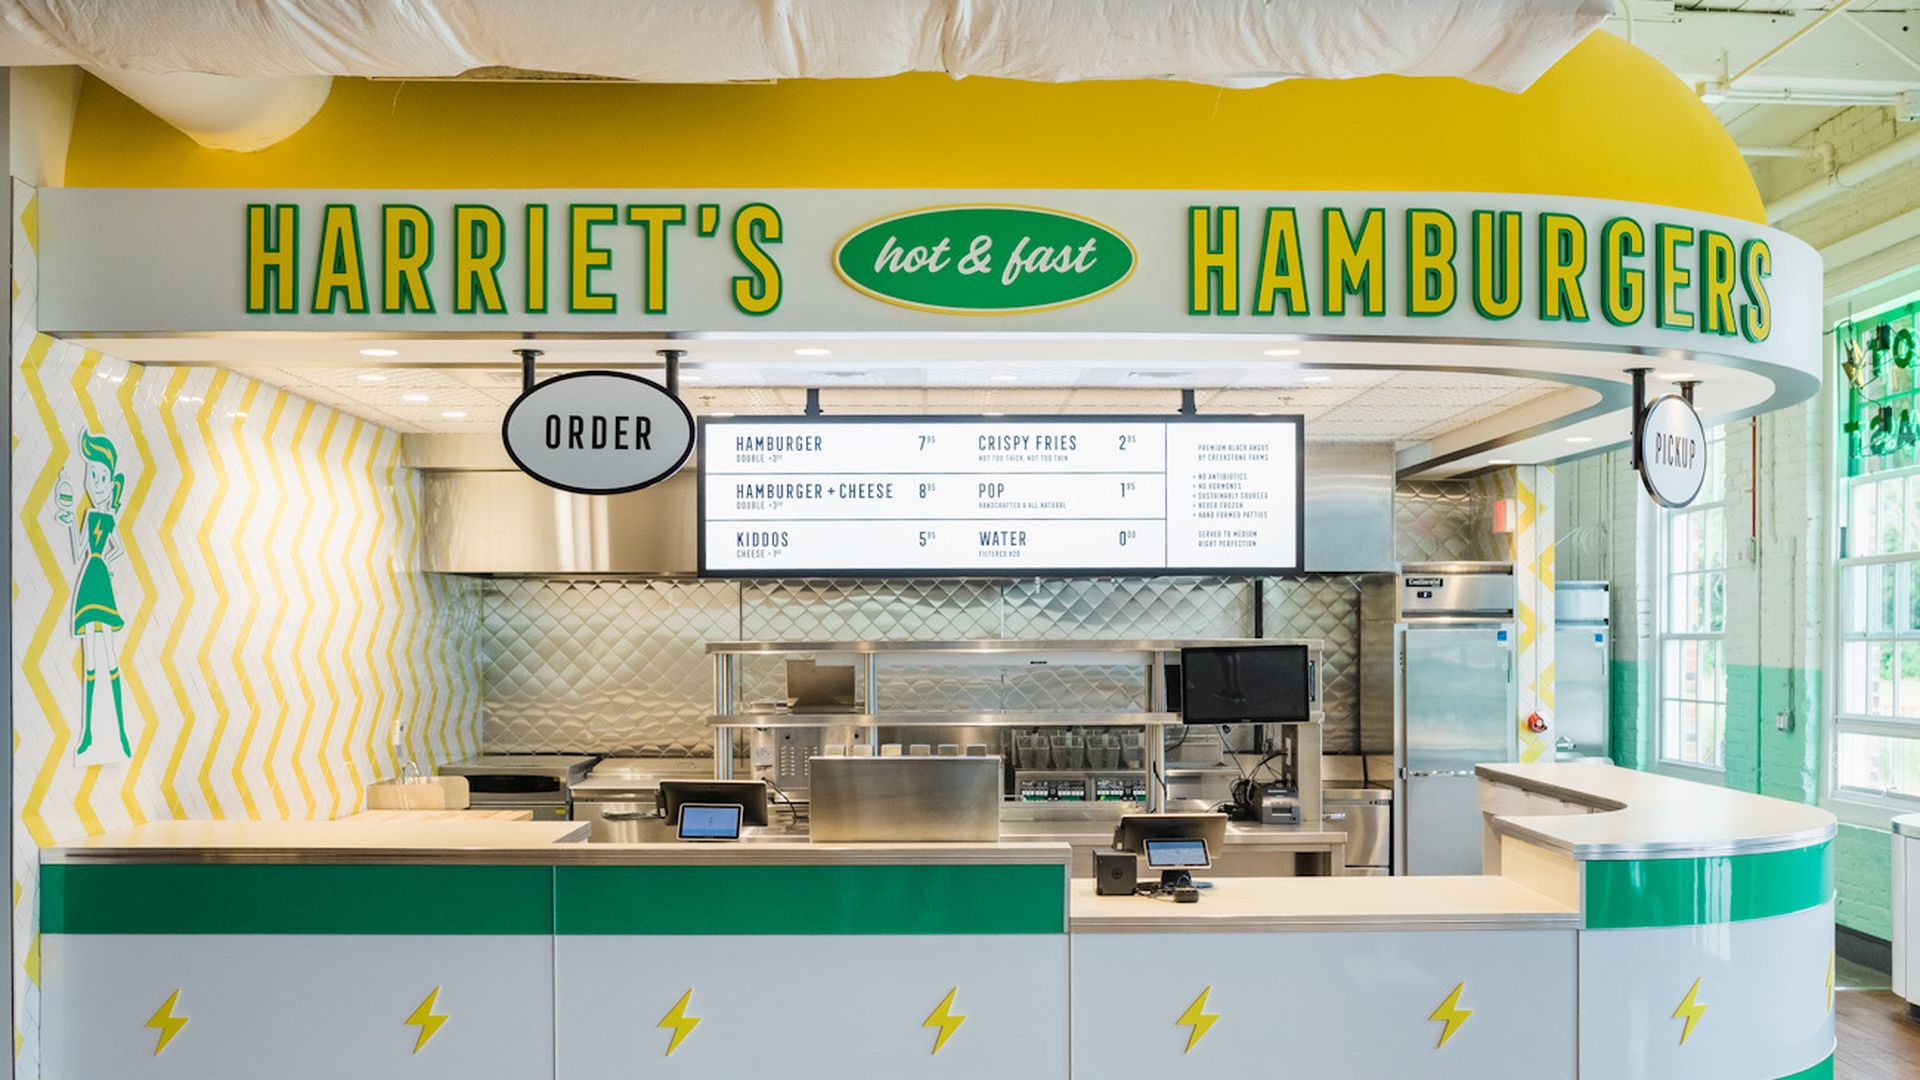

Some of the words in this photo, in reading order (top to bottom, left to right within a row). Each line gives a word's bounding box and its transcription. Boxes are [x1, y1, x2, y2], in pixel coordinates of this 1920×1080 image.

[246, 203, 783, 315] HARRIET'S
[874, 235, 951, 273] hot
[957, 235, 993, 275] &
[1001, 235, 1098, 286] fast
[1187, 206, 1773, 343] HAMBURGERS
[545, 414, 652, 450] ORDER
[736, 435, 822, 451] HAMBURGER
[979, 435, 1030, 451] CRISPY
[1036, 435, 1076, 451] FRIES
[1655, 432, 1696, 470] PICKUP
[736, 483, 822, 499] HAMBURGER
[828, 487, 835, 495] +
[839, 483, 893, 499] CHEESE
[979, 483, 1004, 498] POP
[737, 531, 788, 547] KIDDOS
[979, 531, 1026, 546] WATER
